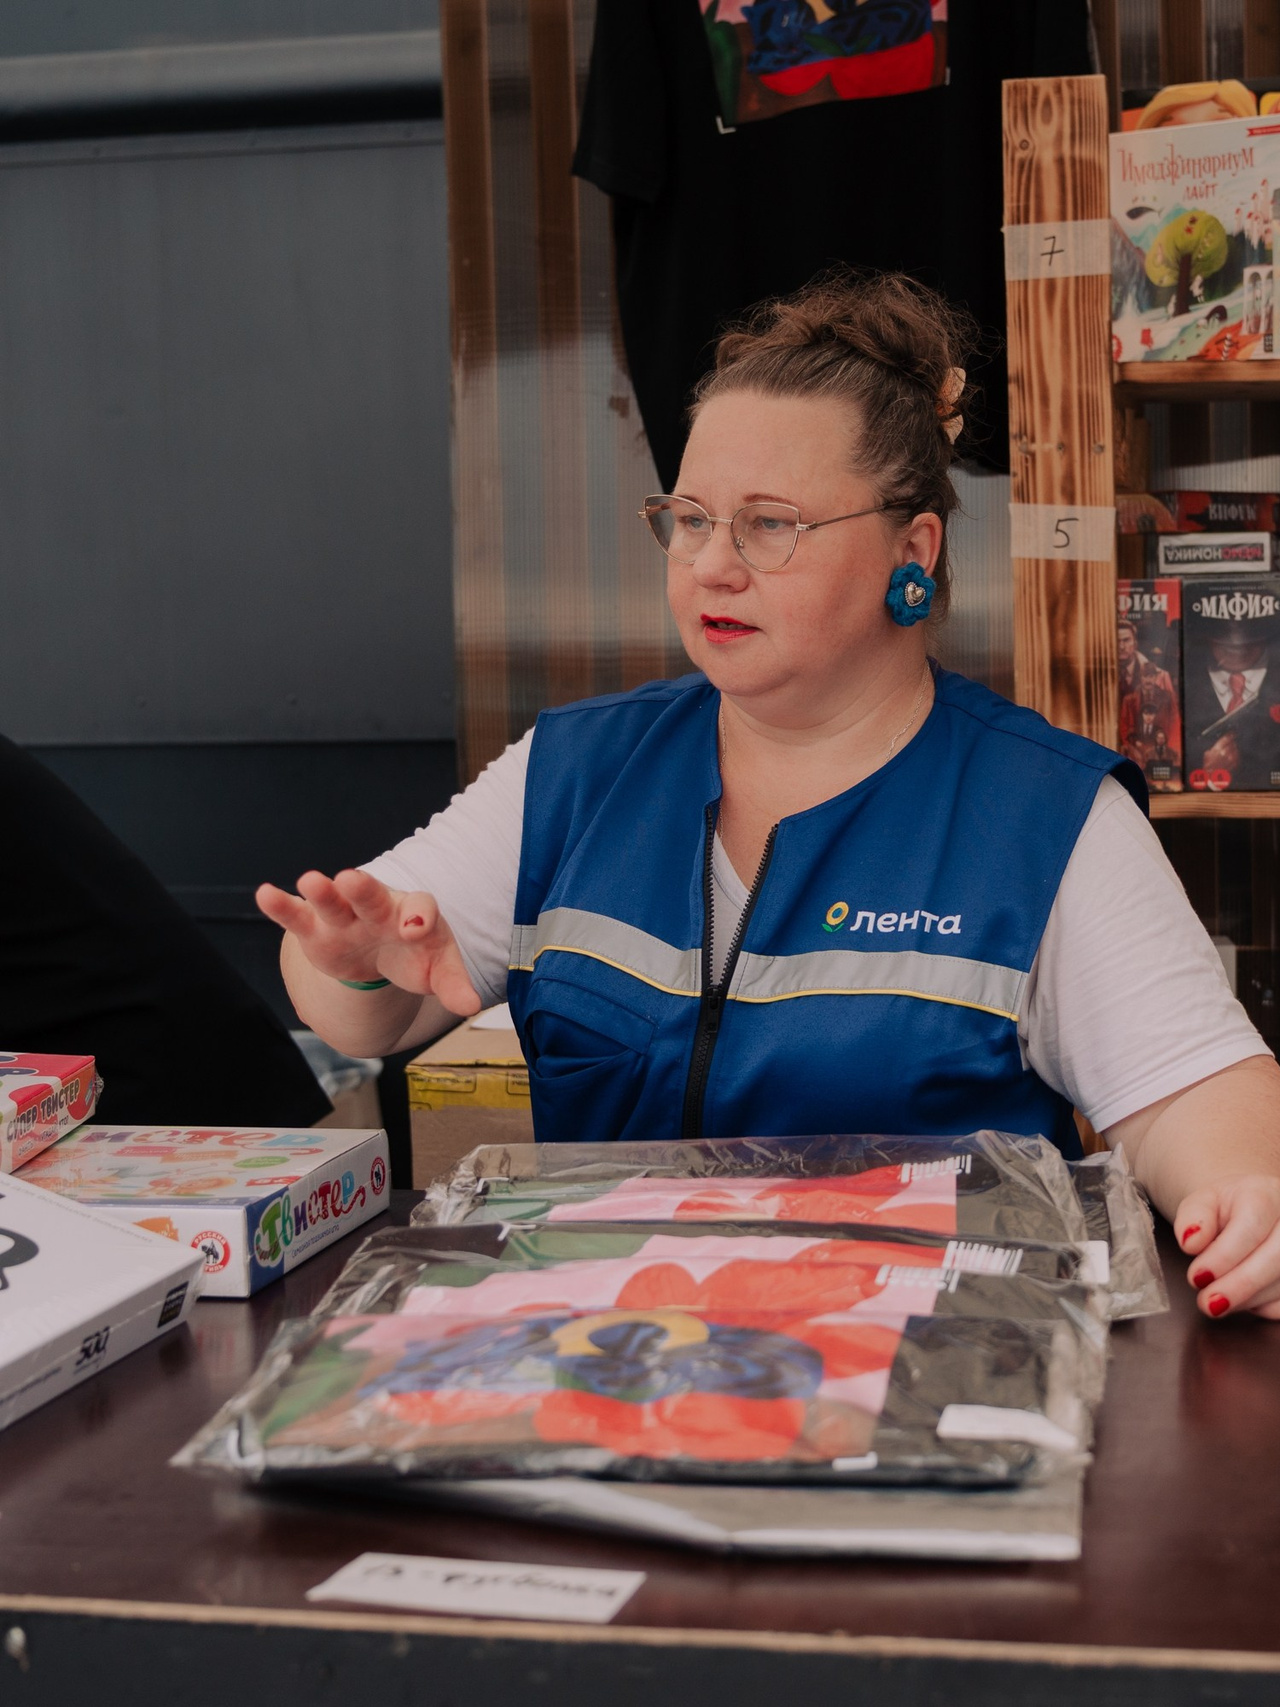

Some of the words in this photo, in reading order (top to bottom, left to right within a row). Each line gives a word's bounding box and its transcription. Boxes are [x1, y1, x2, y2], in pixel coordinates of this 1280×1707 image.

[1116, 144, 1255, 185] Имаджинариум
[1183, 181, 1218, 201] ЛАЙТ
[1040, 235, 1065, 265] 7
[1052, 517, 1079, 549] 5
[1118, 593, 1168, 612] ФИЯ
[1201, 592, 1276, 621] МАФИЯ
[850, 909, 962, 935] лента
[40, 1077, 80, 1123] ТВИСТЕР
[194, 1231, 227, 1245] РУССКИЙ
[204, 1264, 224, 1273] ТИЛЬ
